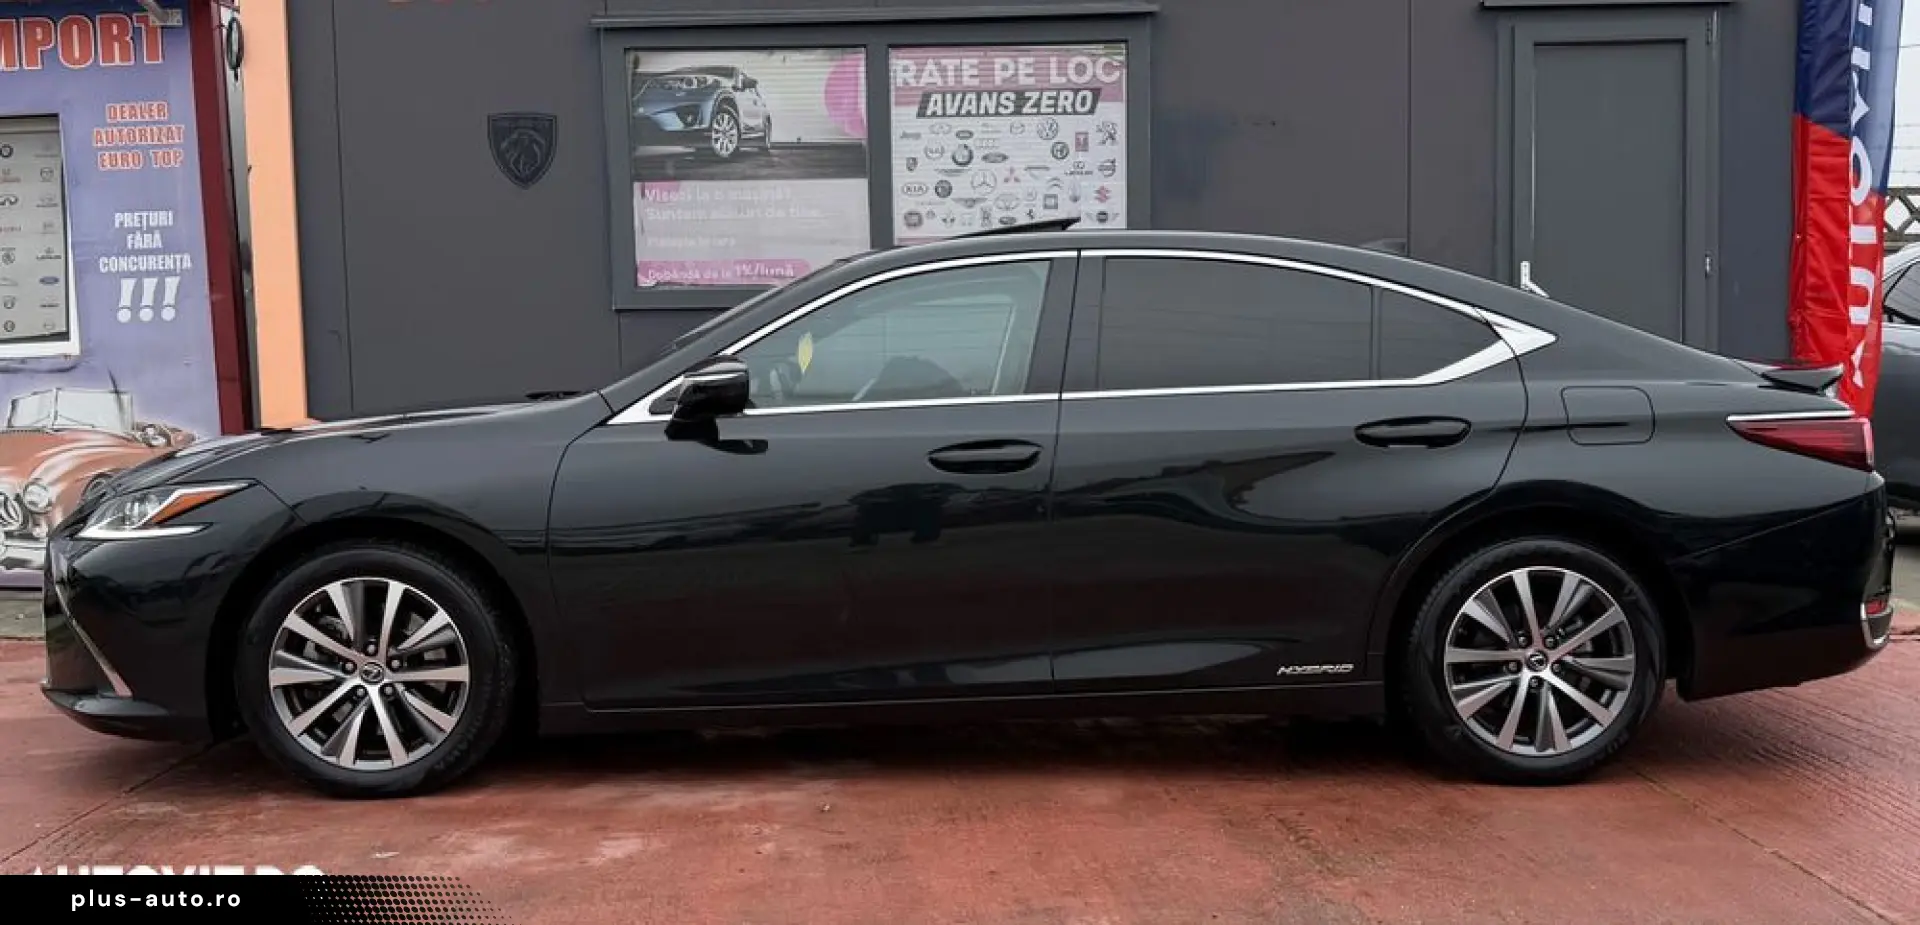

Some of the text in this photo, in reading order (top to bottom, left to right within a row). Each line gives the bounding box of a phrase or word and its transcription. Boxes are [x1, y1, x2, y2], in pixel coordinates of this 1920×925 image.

[894, 54, 1123, 87] RATE PE LOC
[106, 101, 168, 123] DEALER
[925, 89, 1094, 117] AVANS ZERO
[93, 125, 184, 147] AUTORIZAT
[98, 149, 184, 171] EURO TOP
[115, 210, 174, 231] PREȚURI
[127, 230, 163, 249] FĂRĂ
[117, 275, 181, 323] !!!
